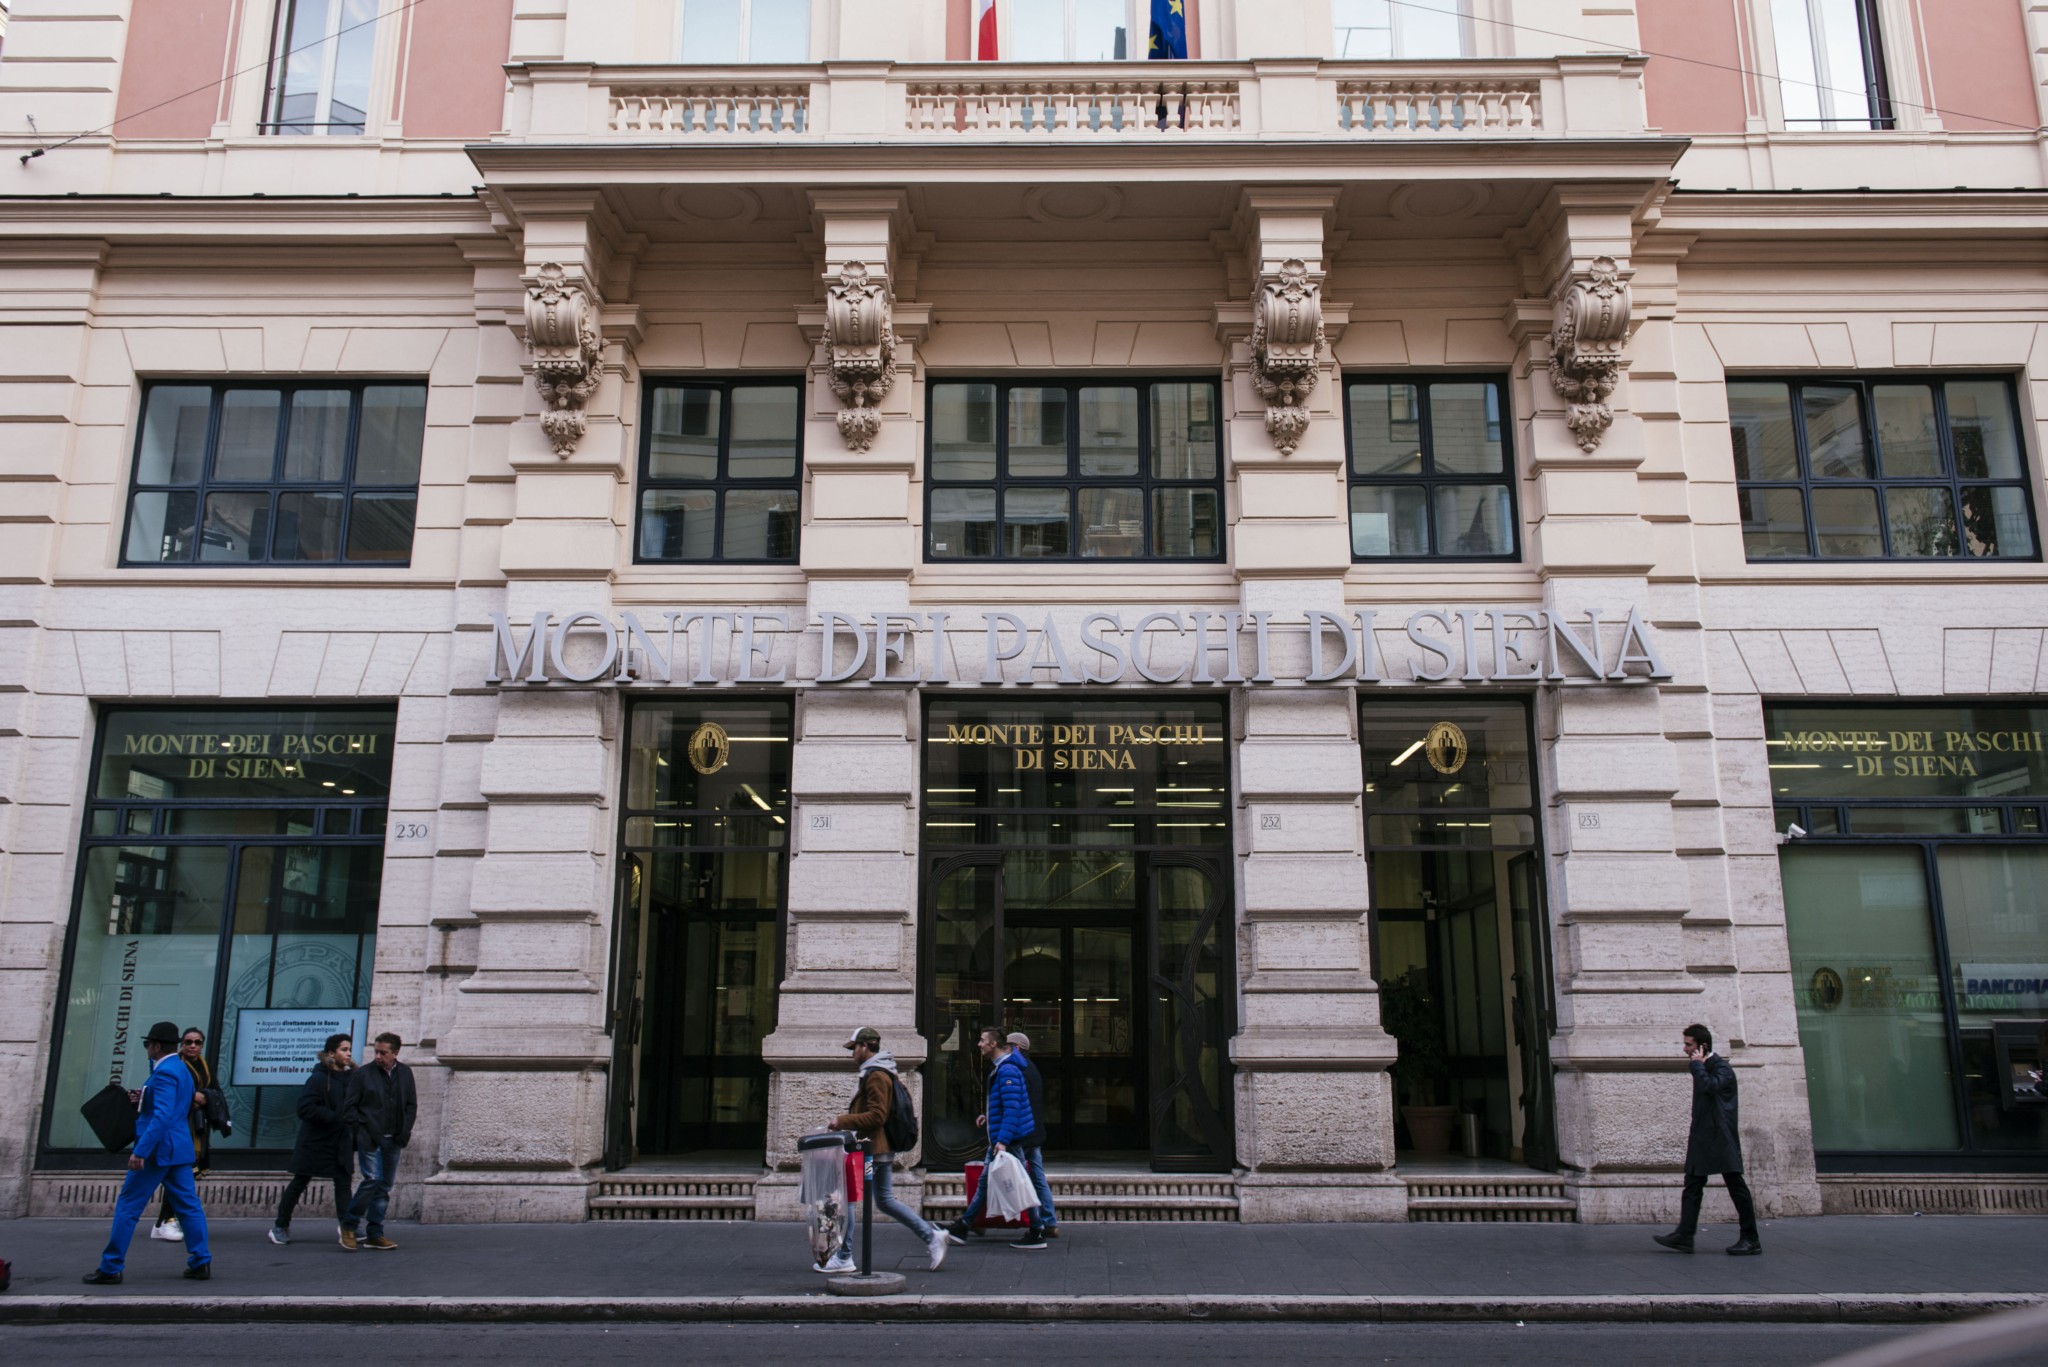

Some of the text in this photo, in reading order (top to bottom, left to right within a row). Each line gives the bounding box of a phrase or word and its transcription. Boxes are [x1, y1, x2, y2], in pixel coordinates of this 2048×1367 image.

[485, 604, 1674, 684] MONTE DEI PASCHI DI SIENA
[124, 734, 378, 755] MONTE DEI PASCHI
[946, 724, 1205, 745] MONTE DEI PASCHI
[1783, 731, 2044, 752] MONTE DEI PASCHI
[188, 758, 305, 779] DI SIENA
[1015, 749, 1136, 770] DI SIENA
[1854, 755, 1978, 776] DI SIENA
[397, 824, 428, 838] 230
[813, 816, 829, 828] 231
[1263, 816, 1280, 828] 232
[1580, 815, 1598, 827] 233
[1967, 979, 2048, 994] BANCOMA
[109, 940, 139, 1086] DEI PASCHI DI SIENA
